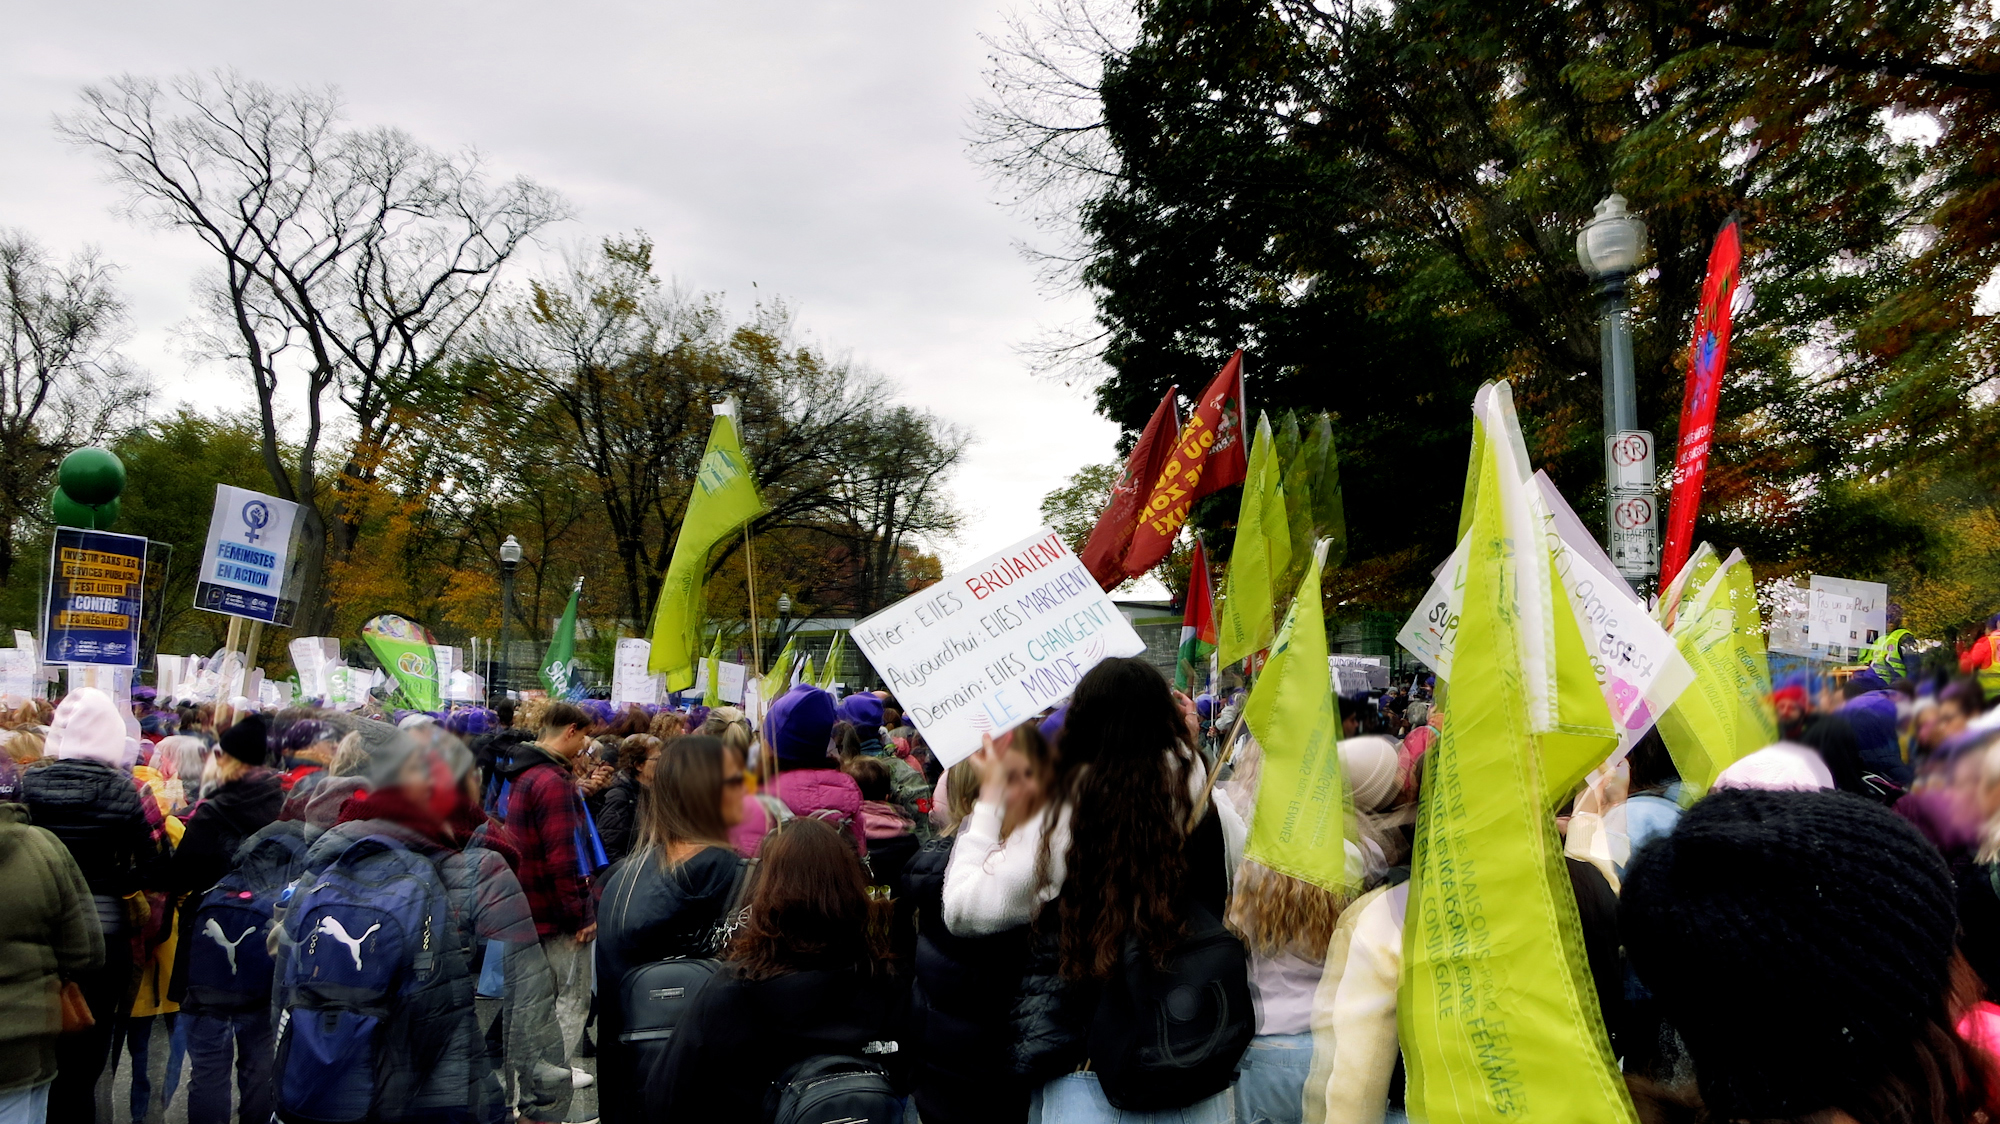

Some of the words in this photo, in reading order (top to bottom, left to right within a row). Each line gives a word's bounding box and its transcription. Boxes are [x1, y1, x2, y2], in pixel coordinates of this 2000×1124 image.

[64, 550, 98, 564] INVESTIR
[123, 558, 136, 568] LES
[66, 565, 103, 578] SERVICES
[218, 543, 275, 570] FÉMINISTES
[75, 582, 95, 592] C'EST
[97, 584, 123, 594] LUTTER
[217, 562, 233, 577] EN
[234, 567, 270, 586] ACTION
[75, 595, 119, 613] CONTRE
[1016, 564, 1093, 620] MARCHENT
[68, 613, 81, 624] LES
[82, 614, 124, 627] INÉGALITÉS
[1027, 600, 1112, 662] CHANGENT
[1232, 612, 1246, 644] FEMMES
[1681, 643, 1707, 674] VICTIMES
[1704, 682, 1729, 722] VIOLENCE
[1720, 653, 1749, 690] VICTIMES
[982, 690, 1021, 728] LE
[1020, 651, 1083, 706] MONDE
[1461, 860, 1492, 962] MAISONS
[1422, 896, 1454, 1020] CONJUGALE
[1467, 1016, 1516, 1115] FEMMES
